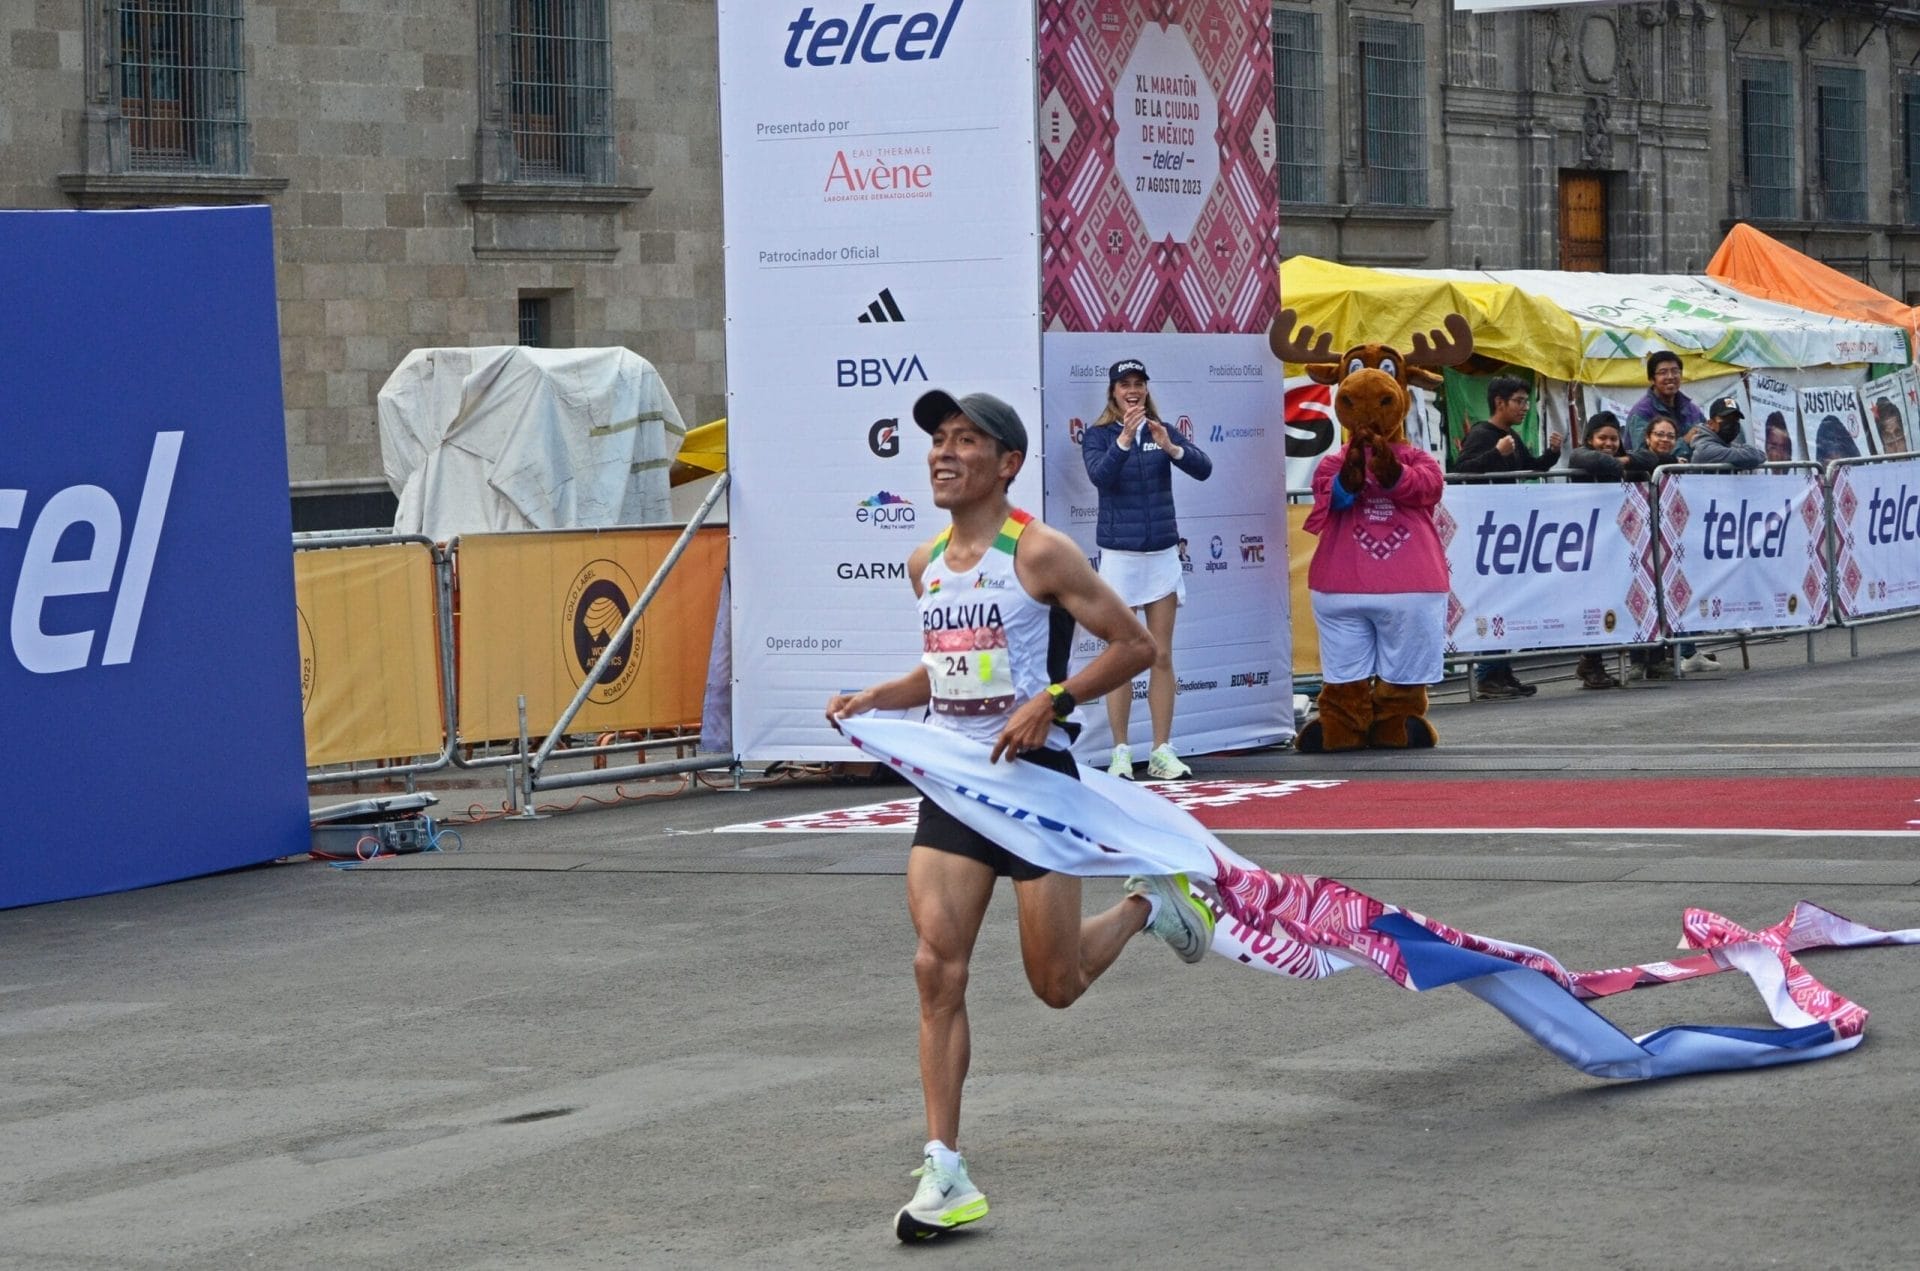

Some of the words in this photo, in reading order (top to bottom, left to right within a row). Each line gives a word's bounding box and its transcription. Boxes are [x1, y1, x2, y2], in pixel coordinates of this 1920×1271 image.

[784, 0, 963, 68] telcel
[1136, 75, 1148, 92] XL
[1135, 98, 1147, 117] DE
[1150, 99, 1162, 117] LA
[1165, 101, 1200, 121] CIUDAD
[757, 120, 825, 135] Presentado
[829, 120, 849, 134] por
[1142, 124, 1154, 143] DE
[853, 150, 872, 158] EAU
[878, 146, 932, 156] THERMALE
[1153, 150, 1184, 170] telcel
[825, 150, 932, 192] Avène
[1136, 176, 1146, 192] 27
[1148, 178, 1180, 195] AGOSTO
[1182, 179, 1202, 195] 2023
[759, 249, 837, 263] Patrocinador
[840, 246, 880, 260] Oficial
[837, 354, 928, 387] BBVA
[1070, 365, 1093, 377] Aliado
[1243, 364, 1263, 376] Oficial
[1804, 390, 1857, 414] JUSTICIA
[1070, 506, 1098, 517] Provee
[1868, 484, 1920, 545] telc
[1703, 499, 1791, 560] telcel
[1476, 508, 1600, 575] telcel
[0, 431, 184, 673] el
[577, 569, 596, 592] LABEL
[837, 563, 905, 579] GARM
[923, 603, 1004, 630] BOLIVIA
[766, 636, 818, 650] Operado
[822, 636, 842, 650] por
[1080, 639, 1095, 652] edia
[945, 655, 969, 676] 24
[603, 683, 622, 697] ROAD
[621, 661, 636, 686] RACE
